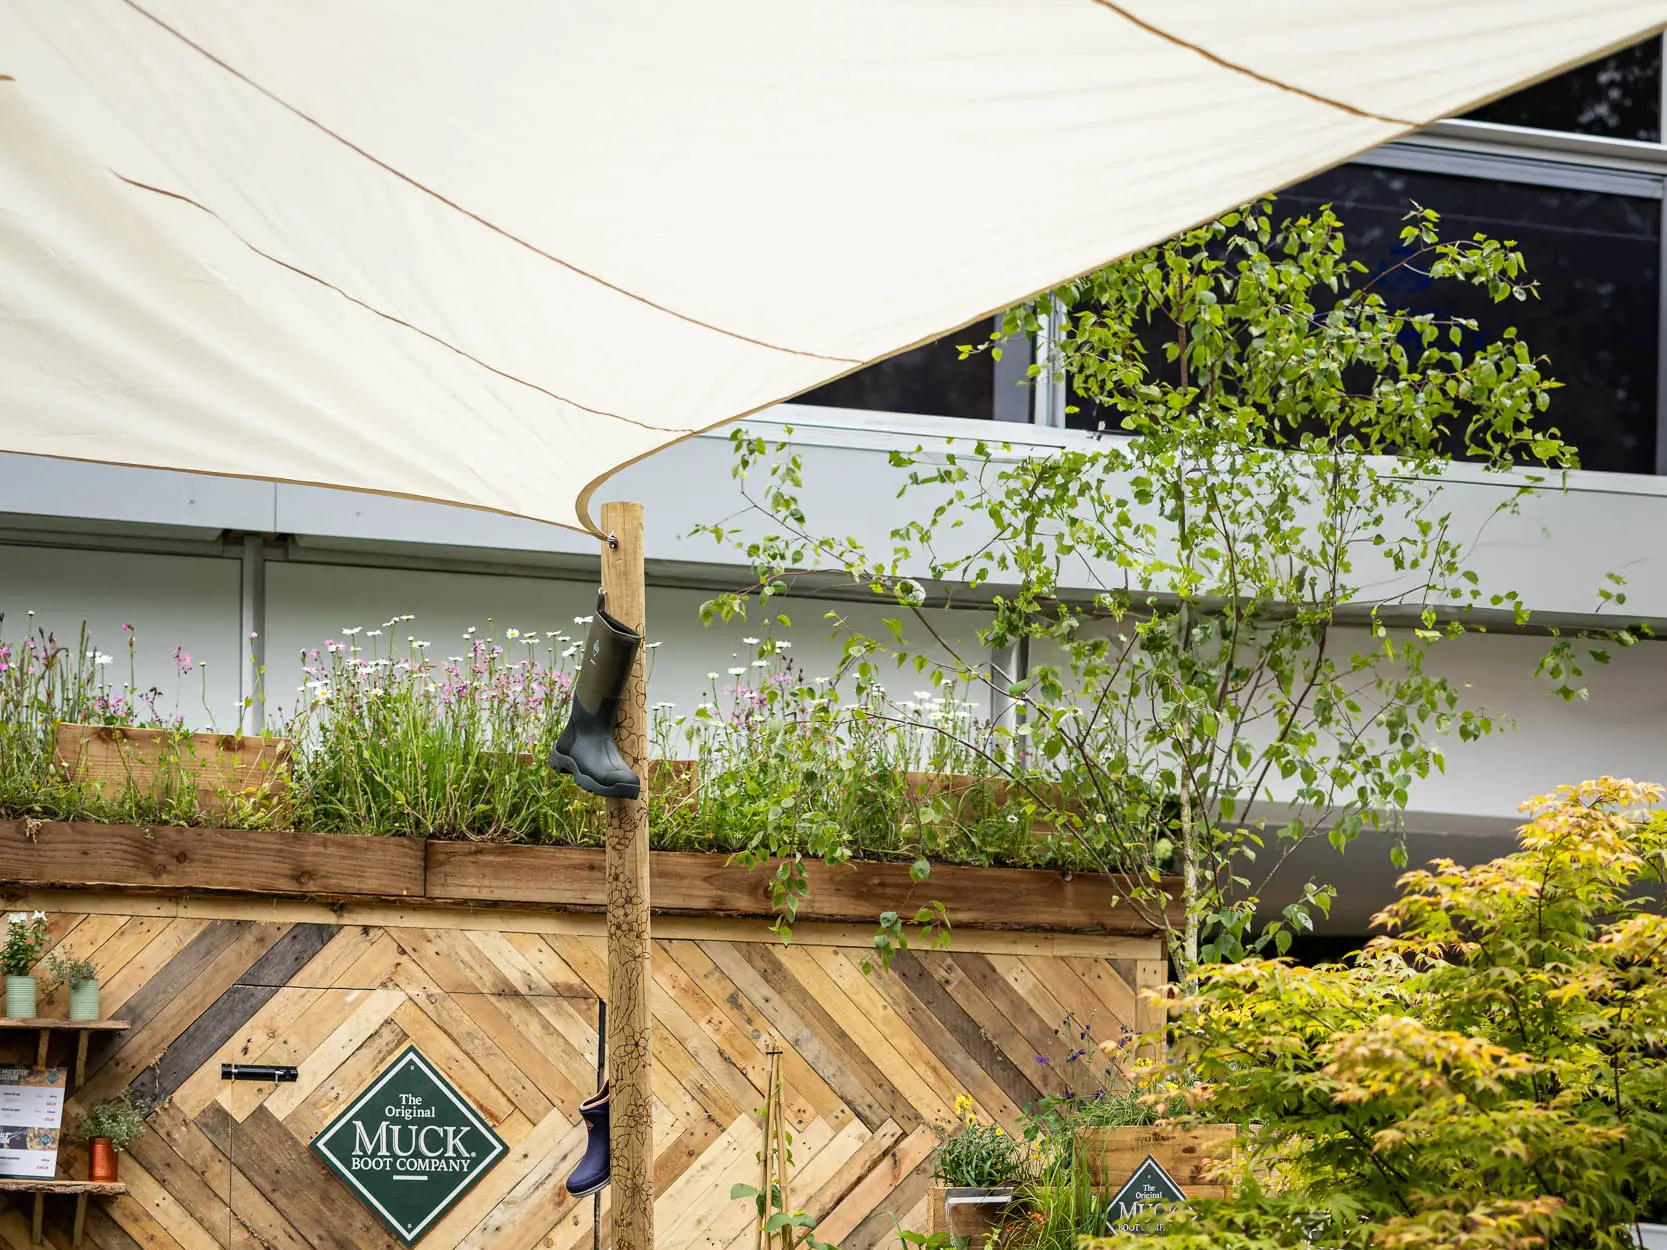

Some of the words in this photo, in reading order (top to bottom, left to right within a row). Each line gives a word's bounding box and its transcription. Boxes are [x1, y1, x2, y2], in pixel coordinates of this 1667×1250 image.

[399, 1093, 422, 1105] The
[385, 1106, 435, 1120] Original
[352, 1158, 393, 1170] BOOT
[396, 1158, 471, 1172] COMPANY
